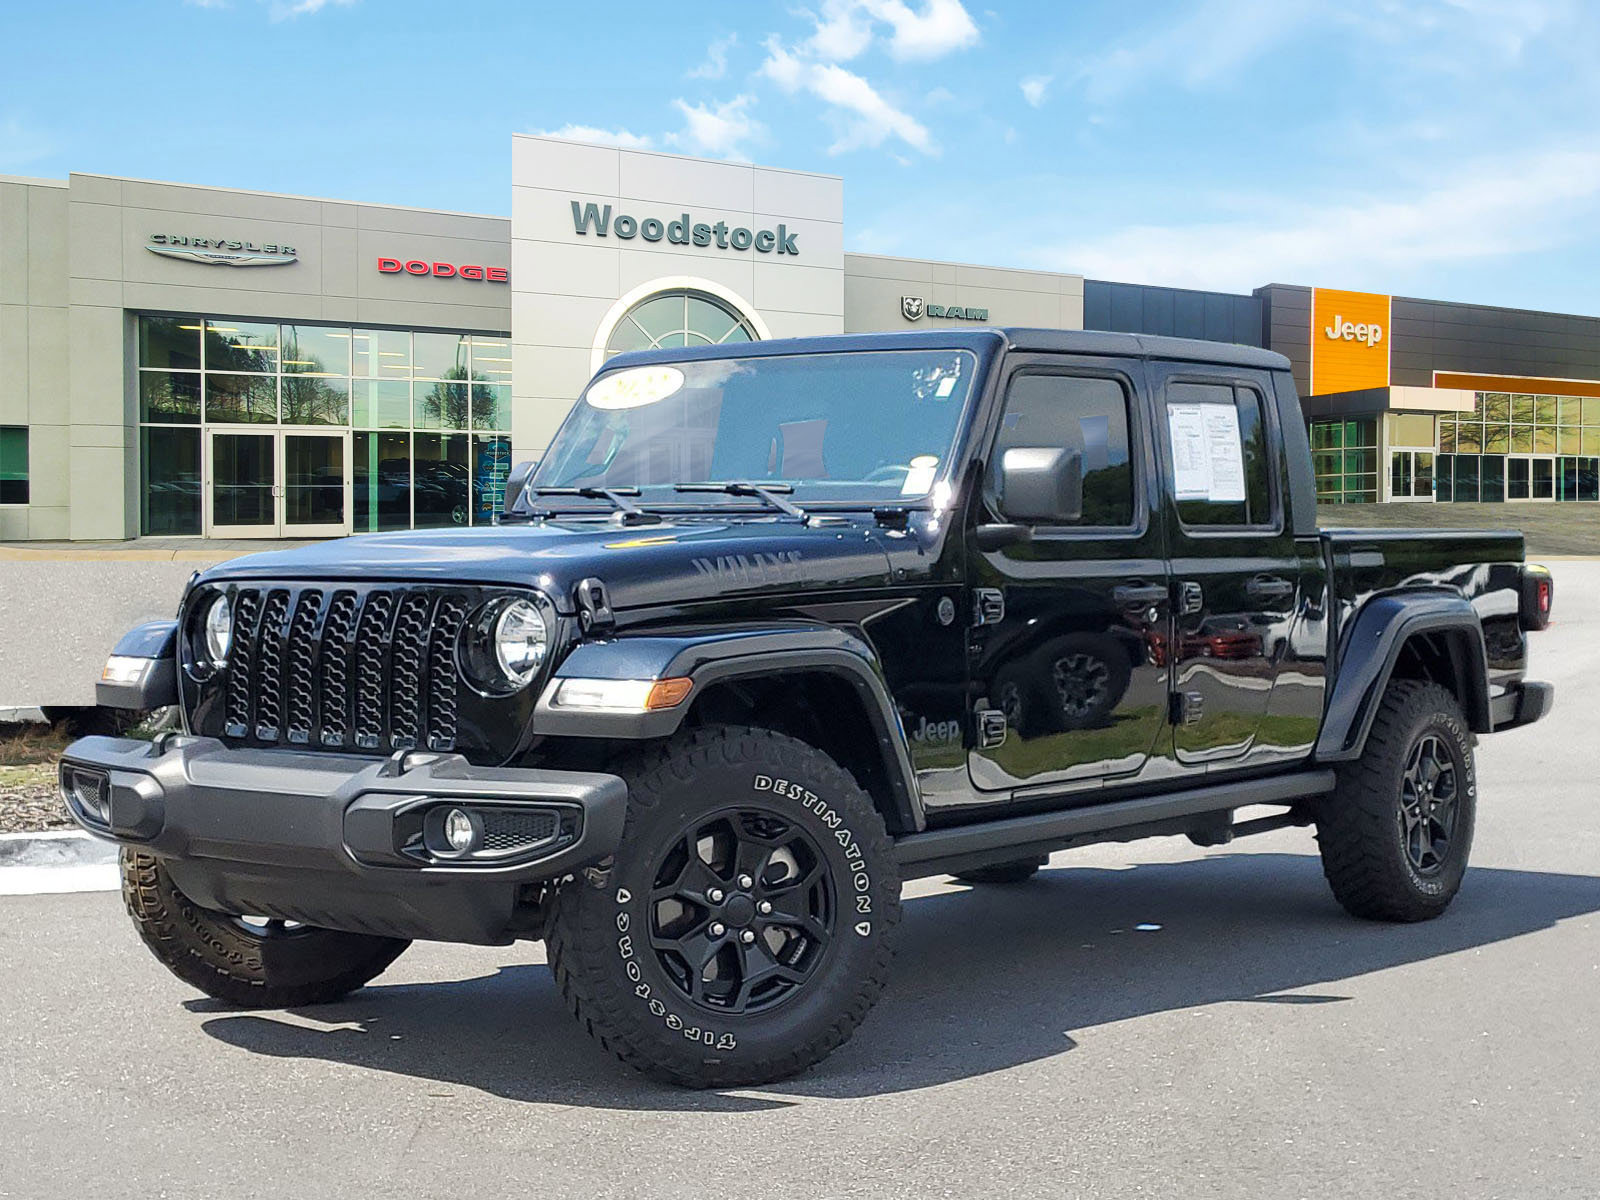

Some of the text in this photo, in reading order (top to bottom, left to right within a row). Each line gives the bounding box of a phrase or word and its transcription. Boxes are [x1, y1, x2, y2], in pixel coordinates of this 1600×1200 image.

[570, 200, 799, 254] Woodstock
[150, 234, 296, 255] CHRYSLER
[378, 257, 508, 282] DODGE
[927, 304, 989, 321] RAM
[1325, 314, 1382, 347] Jeep
[914, 716, 960, 741] Jeep
[754, 775, 872, 914] DESTINATION
[616, 912, 736, 1050] Firestone
